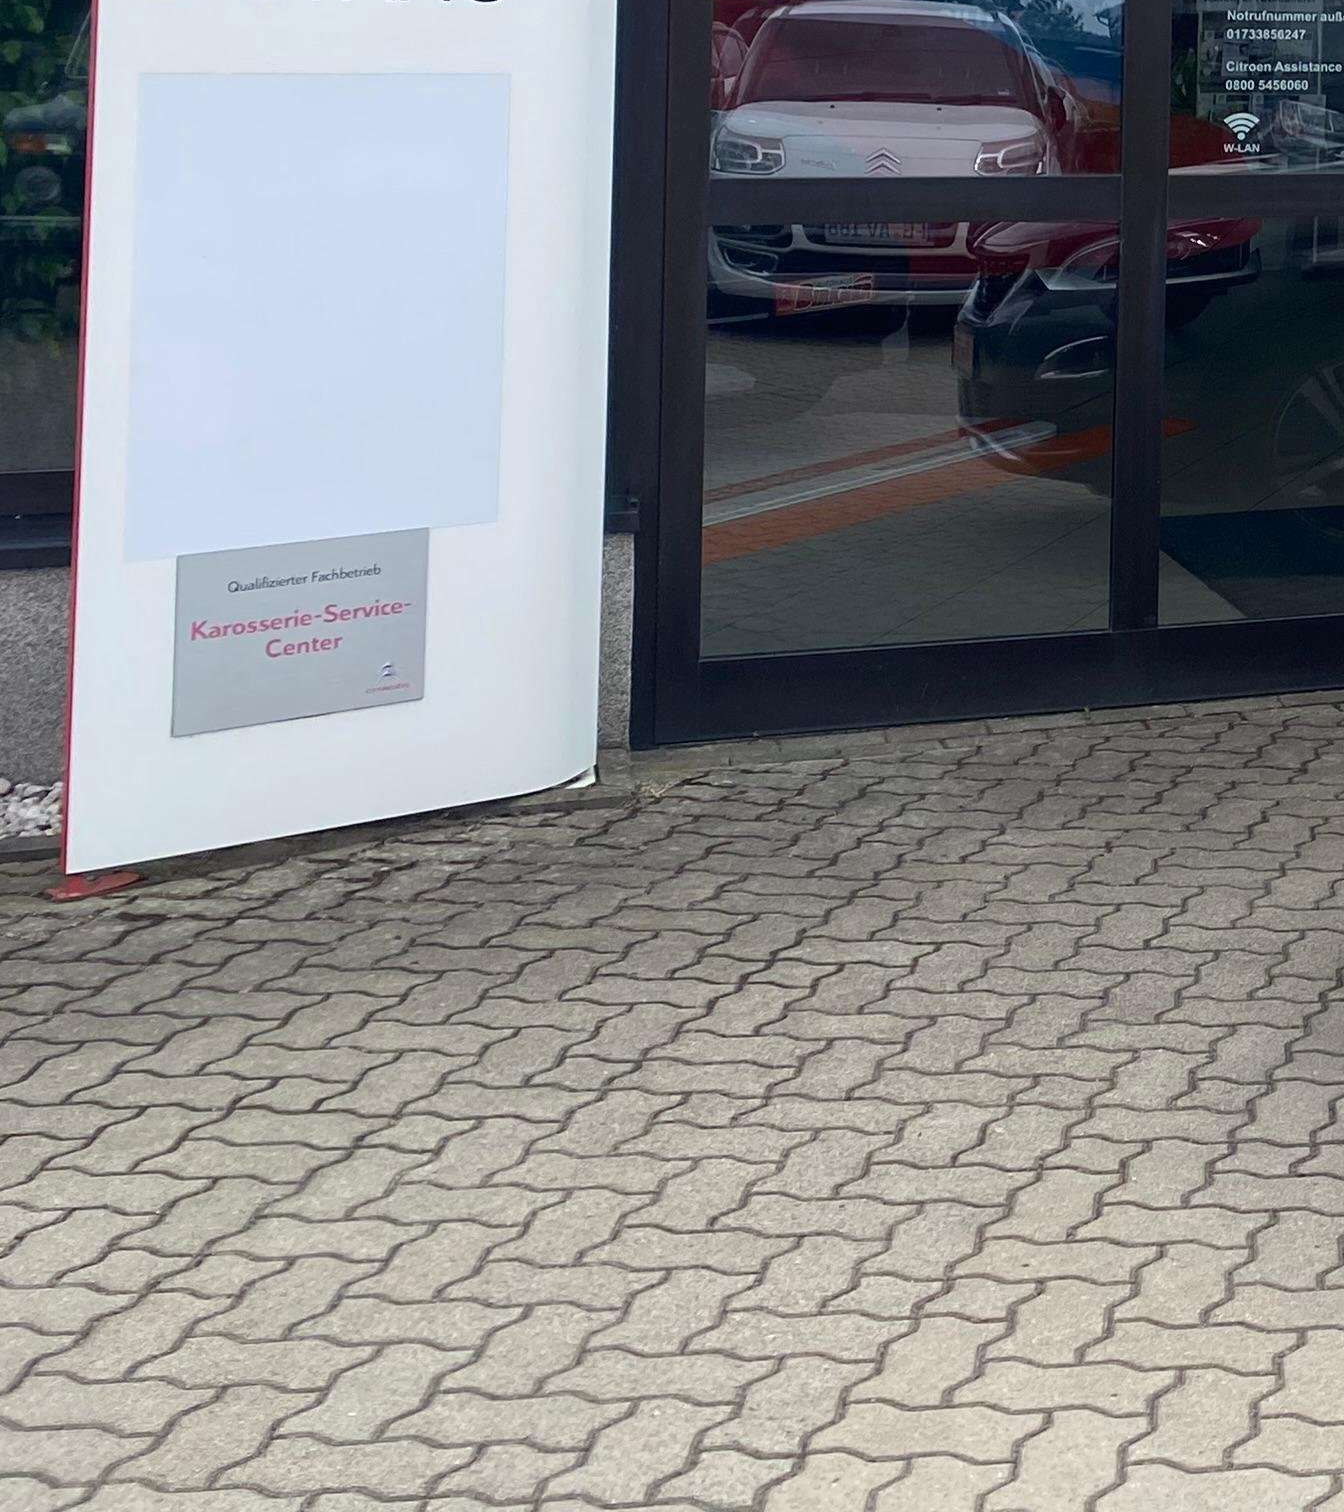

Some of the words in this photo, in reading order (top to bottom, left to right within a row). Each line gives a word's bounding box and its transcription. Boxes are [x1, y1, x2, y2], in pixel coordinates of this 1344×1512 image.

[1226, 10, 1318, 23] Notrufnummer
[1226, 61, 1272, 73] Citroen
[1275, 61, 1342, 73] Assistance
[1225, 79, 1255, 91] 0800
[1258, 80, 1309, 91] 5456060
[1223, 143, 1261, 153] W-LAN
[227, 574, 308, 593] Qualifizierter
[310, 563, 382, 583] Fachbetrieb
[190, 599, 413, 641] Karosserie-Service-
[265, 636, 344, 659] Center
